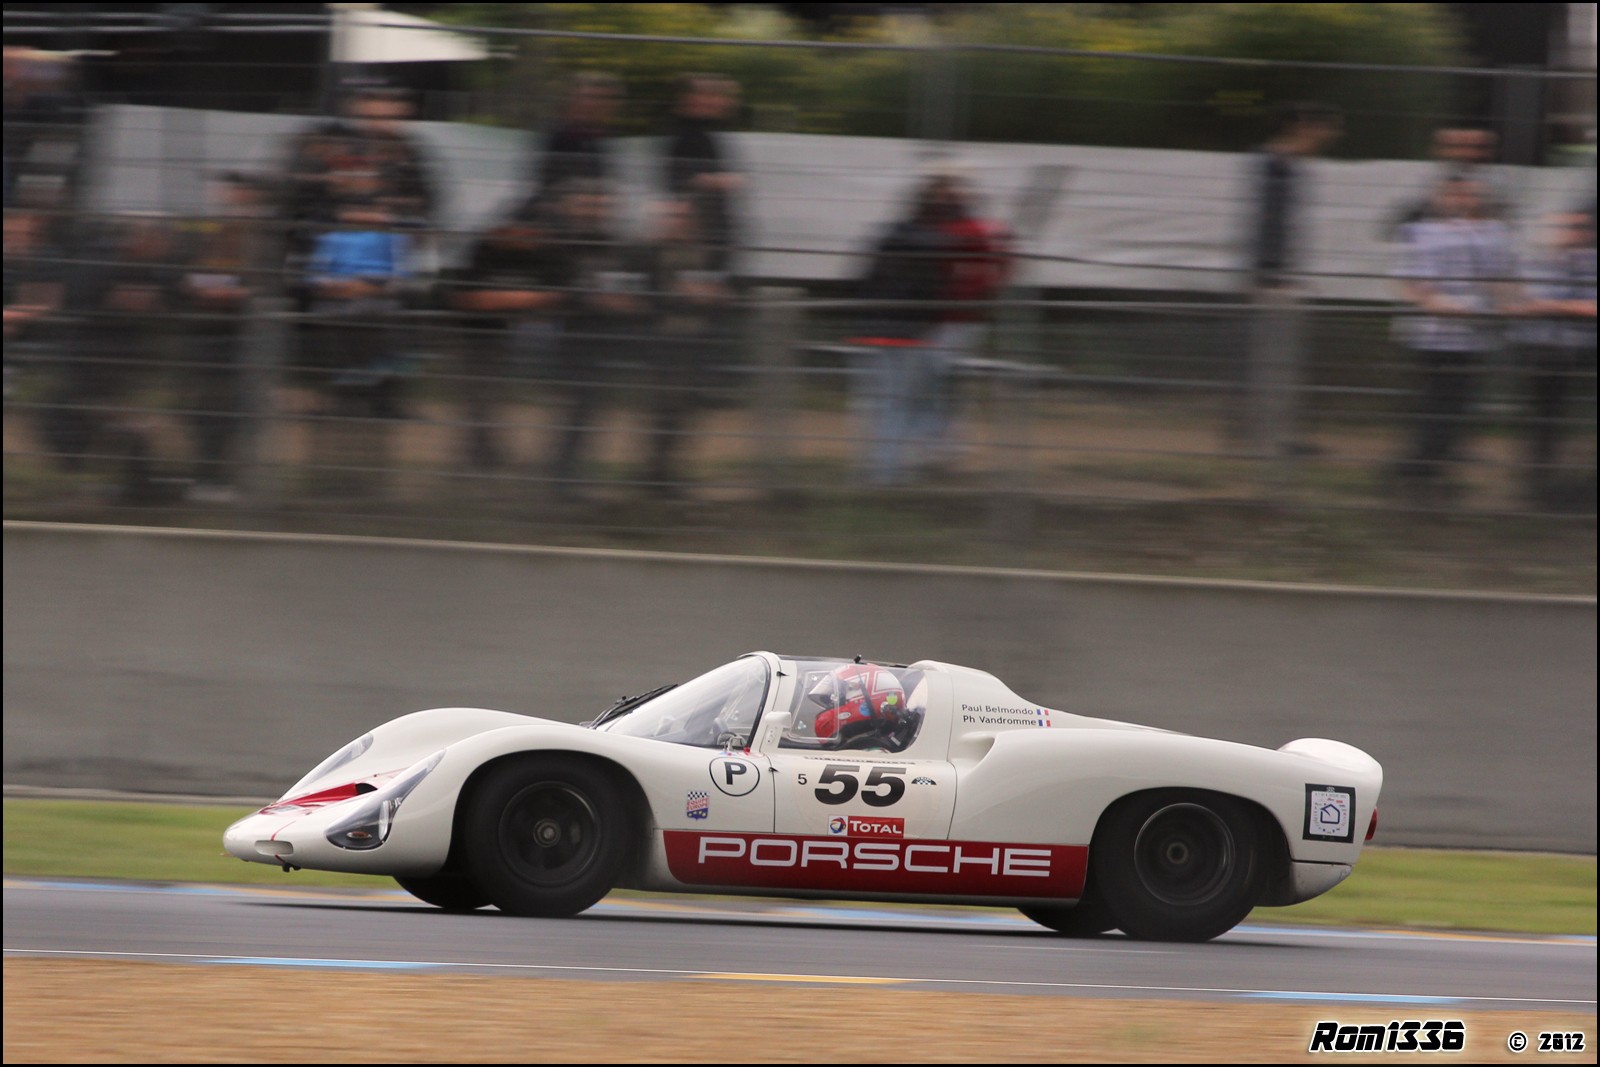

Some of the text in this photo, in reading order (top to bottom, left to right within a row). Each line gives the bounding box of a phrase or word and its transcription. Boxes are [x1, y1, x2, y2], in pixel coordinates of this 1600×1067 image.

[962, 704, 1033, 715] Paul Belmondo
[963, 715, 1036, 726] Ph Vandromme
[724, 761, 747, 785] P
[798, 774, 807, 785] 5
[814, 764, 907, 807] 55
[850, 821, 902, 834] TOTAL
[698, 836, 1052, 877] PORSCHE
